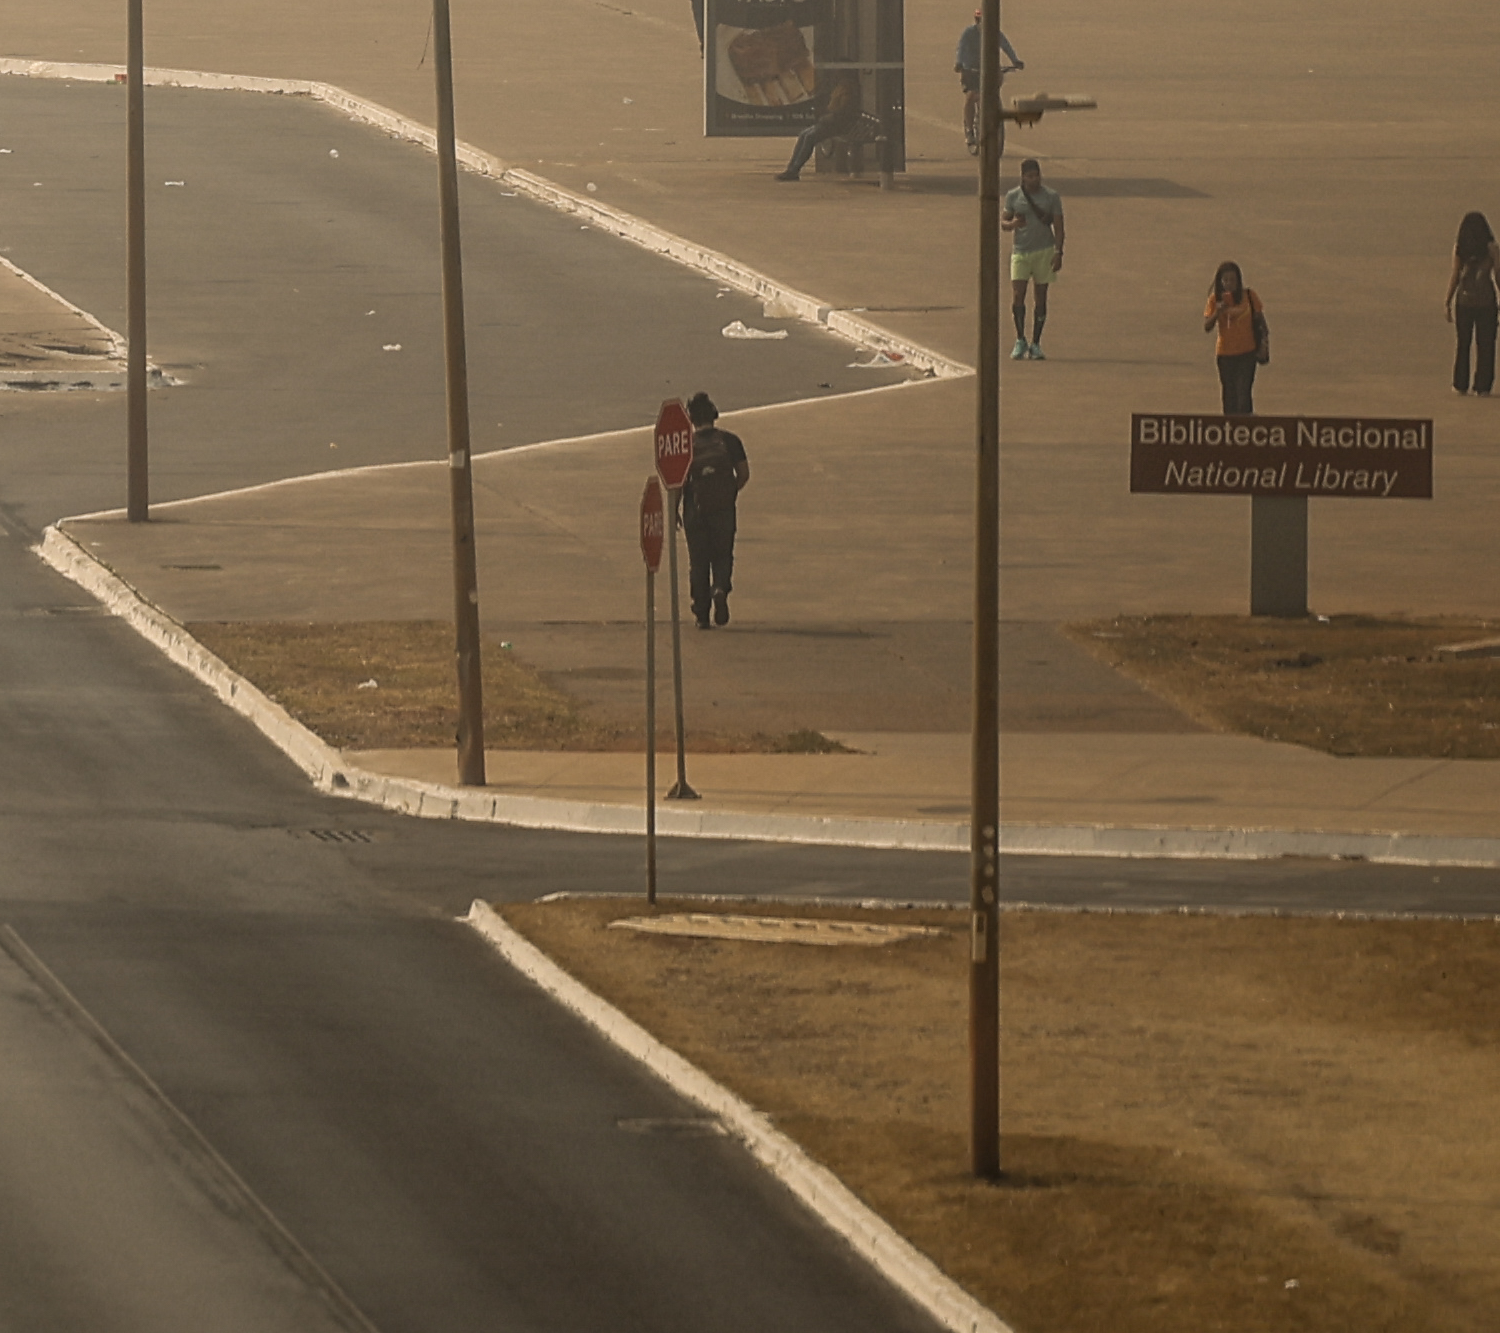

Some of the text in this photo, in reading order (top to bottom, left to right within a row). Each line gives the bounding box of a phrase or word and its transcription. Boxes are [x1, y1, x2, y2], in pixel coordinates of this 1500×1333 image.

[658, 430, 689, 459] PARE
[1139, 418, 1427, 450] Biblioteca Nacional
[1164, 460, 1399, 496] National Library
[643, 512, 664, 537] PARE
